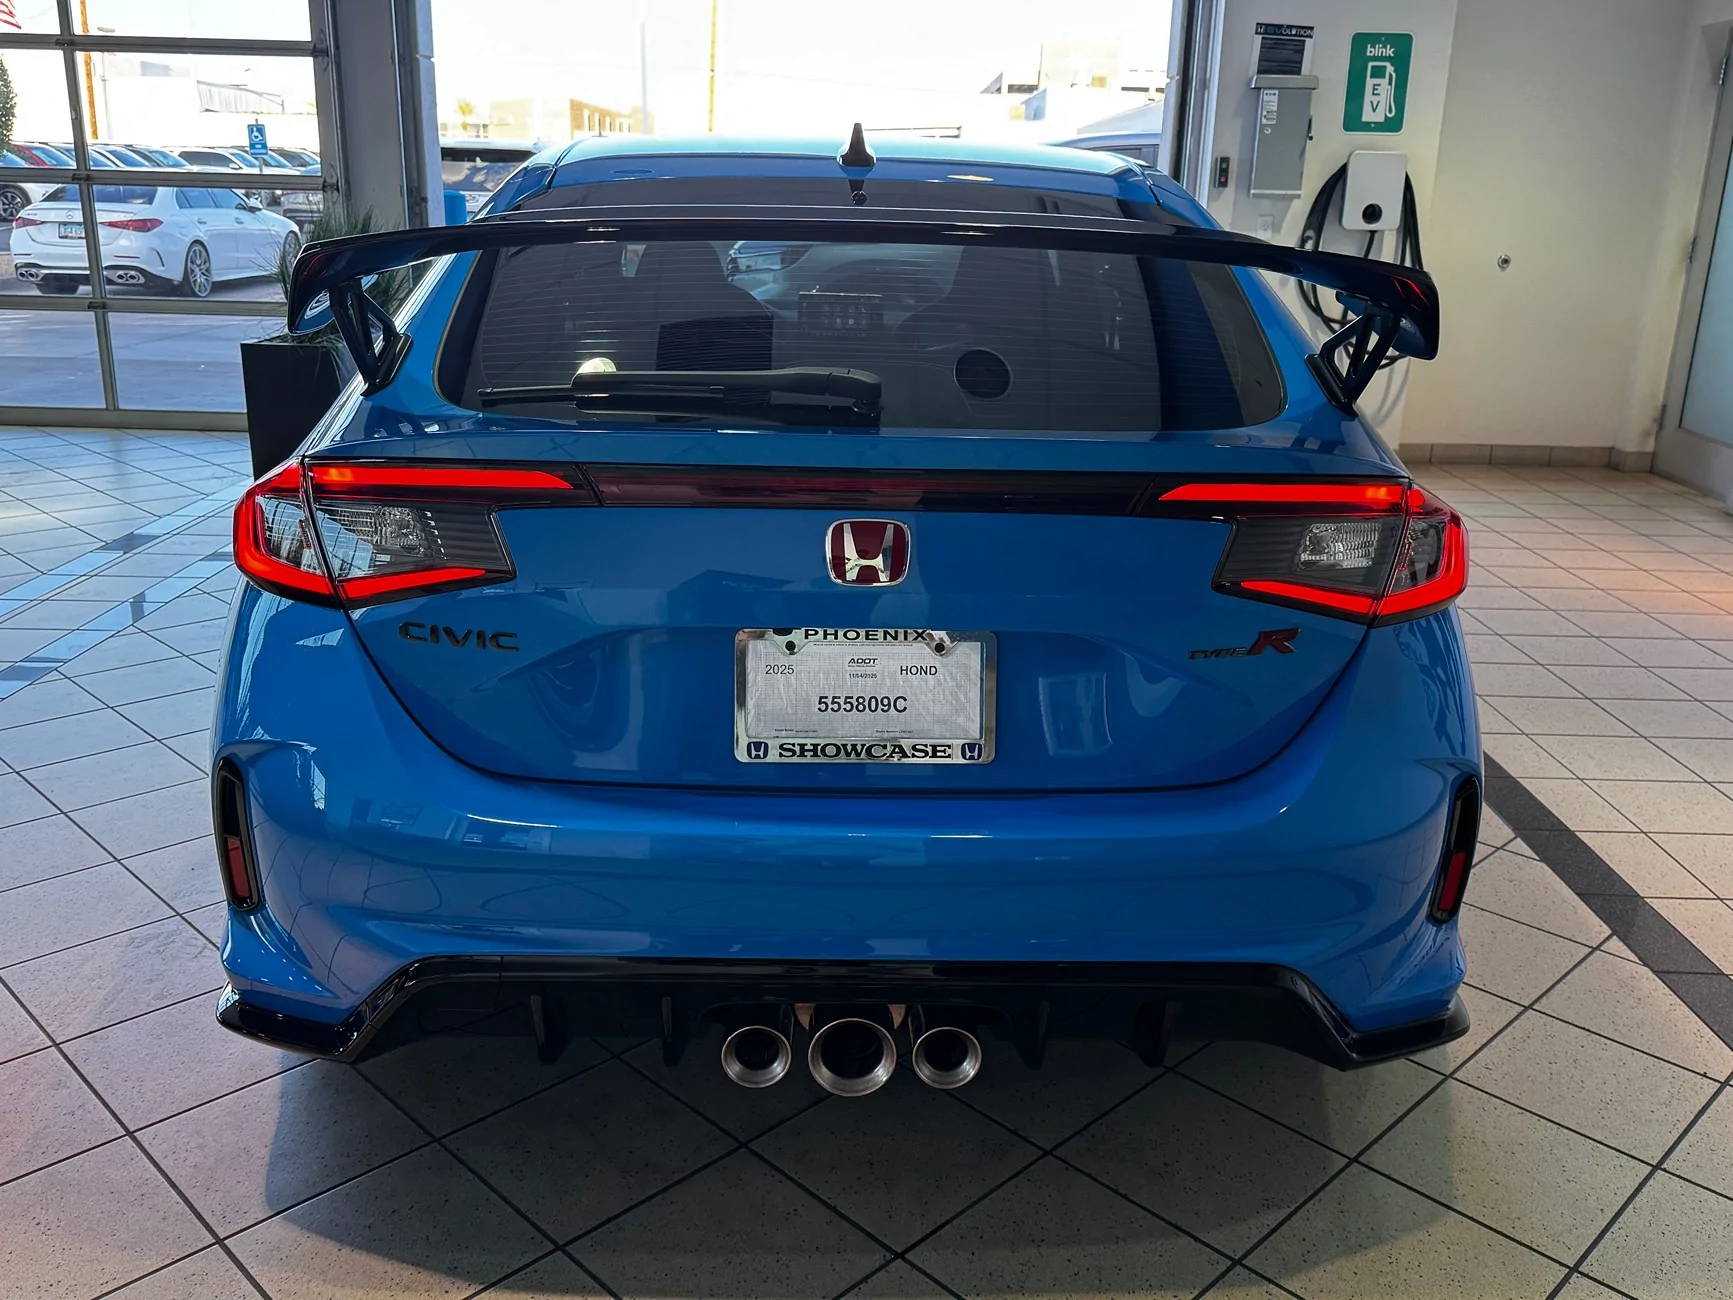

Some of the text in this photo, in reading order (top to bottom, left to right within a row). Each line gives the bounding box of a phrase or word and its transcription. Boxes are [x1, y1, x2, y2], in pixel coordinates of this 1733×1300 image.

[1366, 44, 1395, 56] blink
[398, 621, 519, 652] CIVIC
[804, 629, 928, 641] PHOENIX
[1189, 628, 1301, 660] TYPE R
[765, 664, 795, 675] 2025
[900, 665, 938, 676] HOND
[817, 695, 908, 713] 555809C
[778, 742, 952, 760] SHOWCASE
